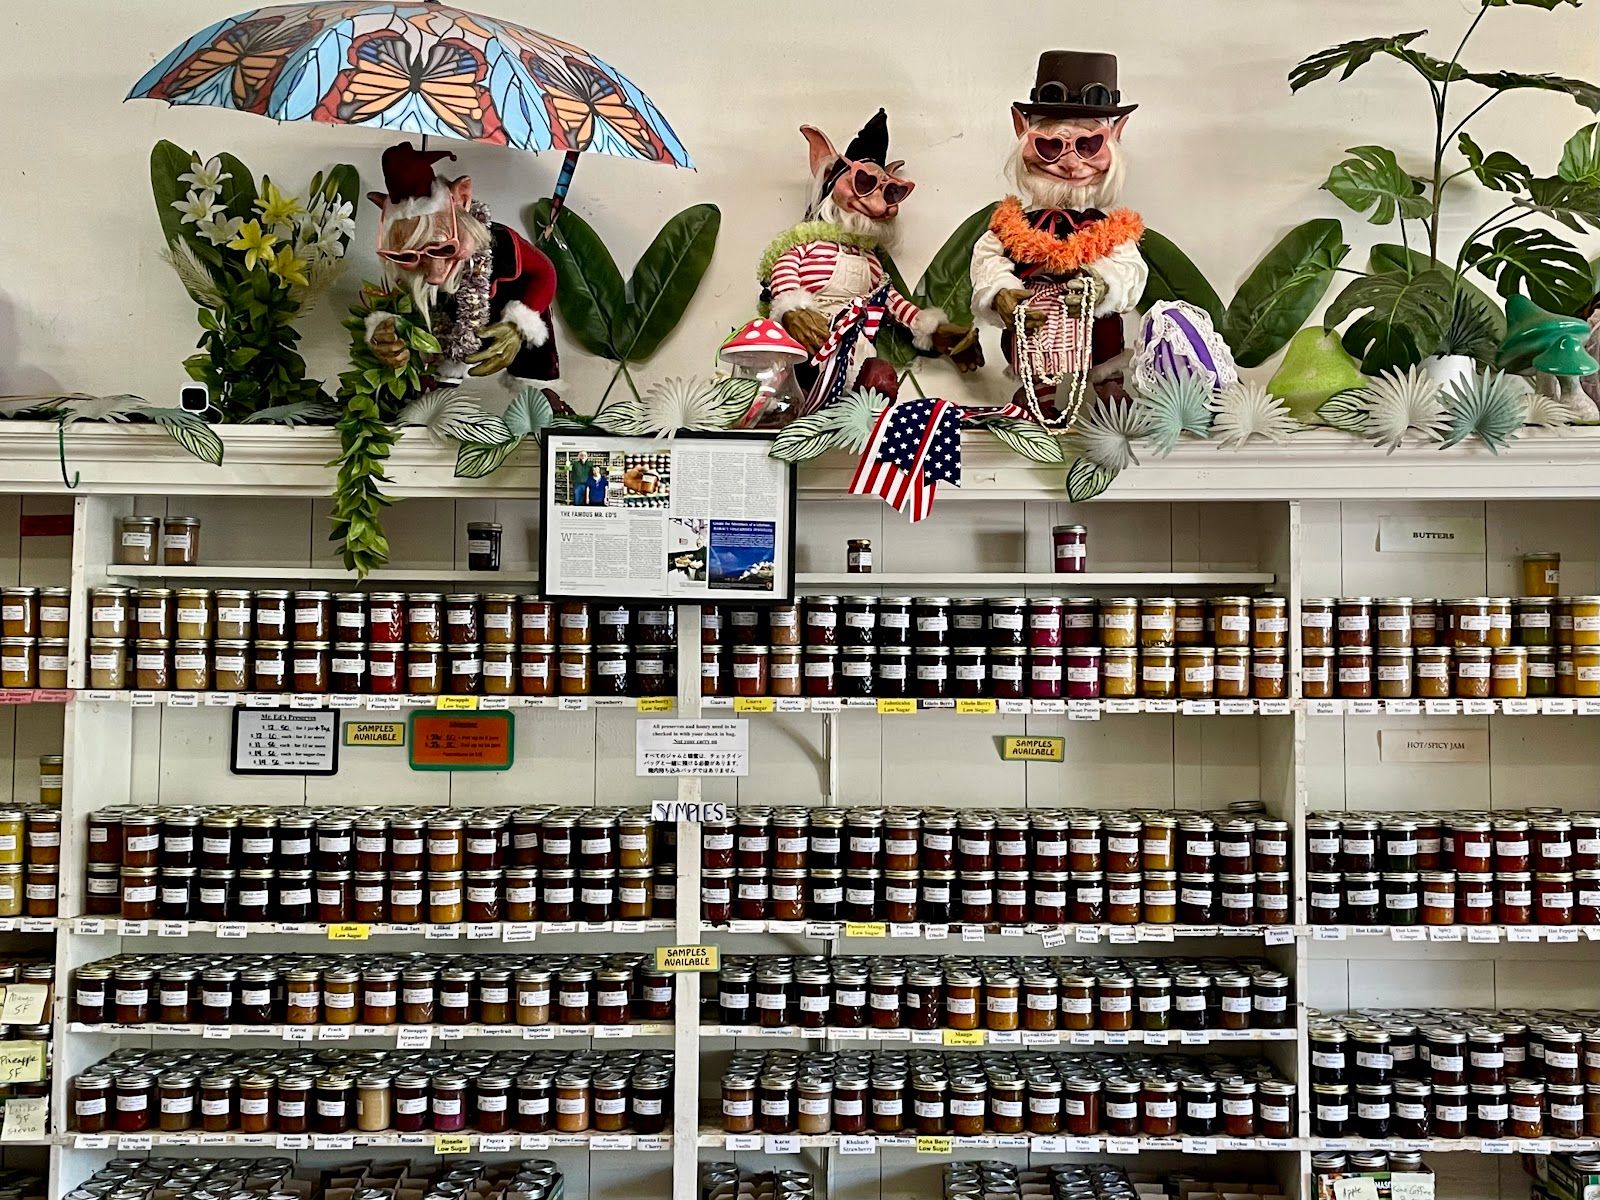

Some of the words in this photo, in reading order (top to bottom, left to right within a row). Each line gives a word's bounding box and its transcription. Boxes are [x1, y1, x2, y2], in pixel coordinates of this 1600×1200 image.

[1412, 532, 1455, 540] BUTTERS
[356, 724, 394, 733] SAMPLES
[353, 732, 397, 741] AVAILABLE
[1015, 739, 1052, 748] SAMPLES
[1449, 742, 1465, 750] JAM
[1012, 748, 1055, 756] AVAILABLE
[656, 802, 724, 823] SAMPLES
[667, 948, 707, 957] SAMPLES
[664, 957, 710, 966] AVAILABLE
[1342, 1186, 1362, 1199] Apple
